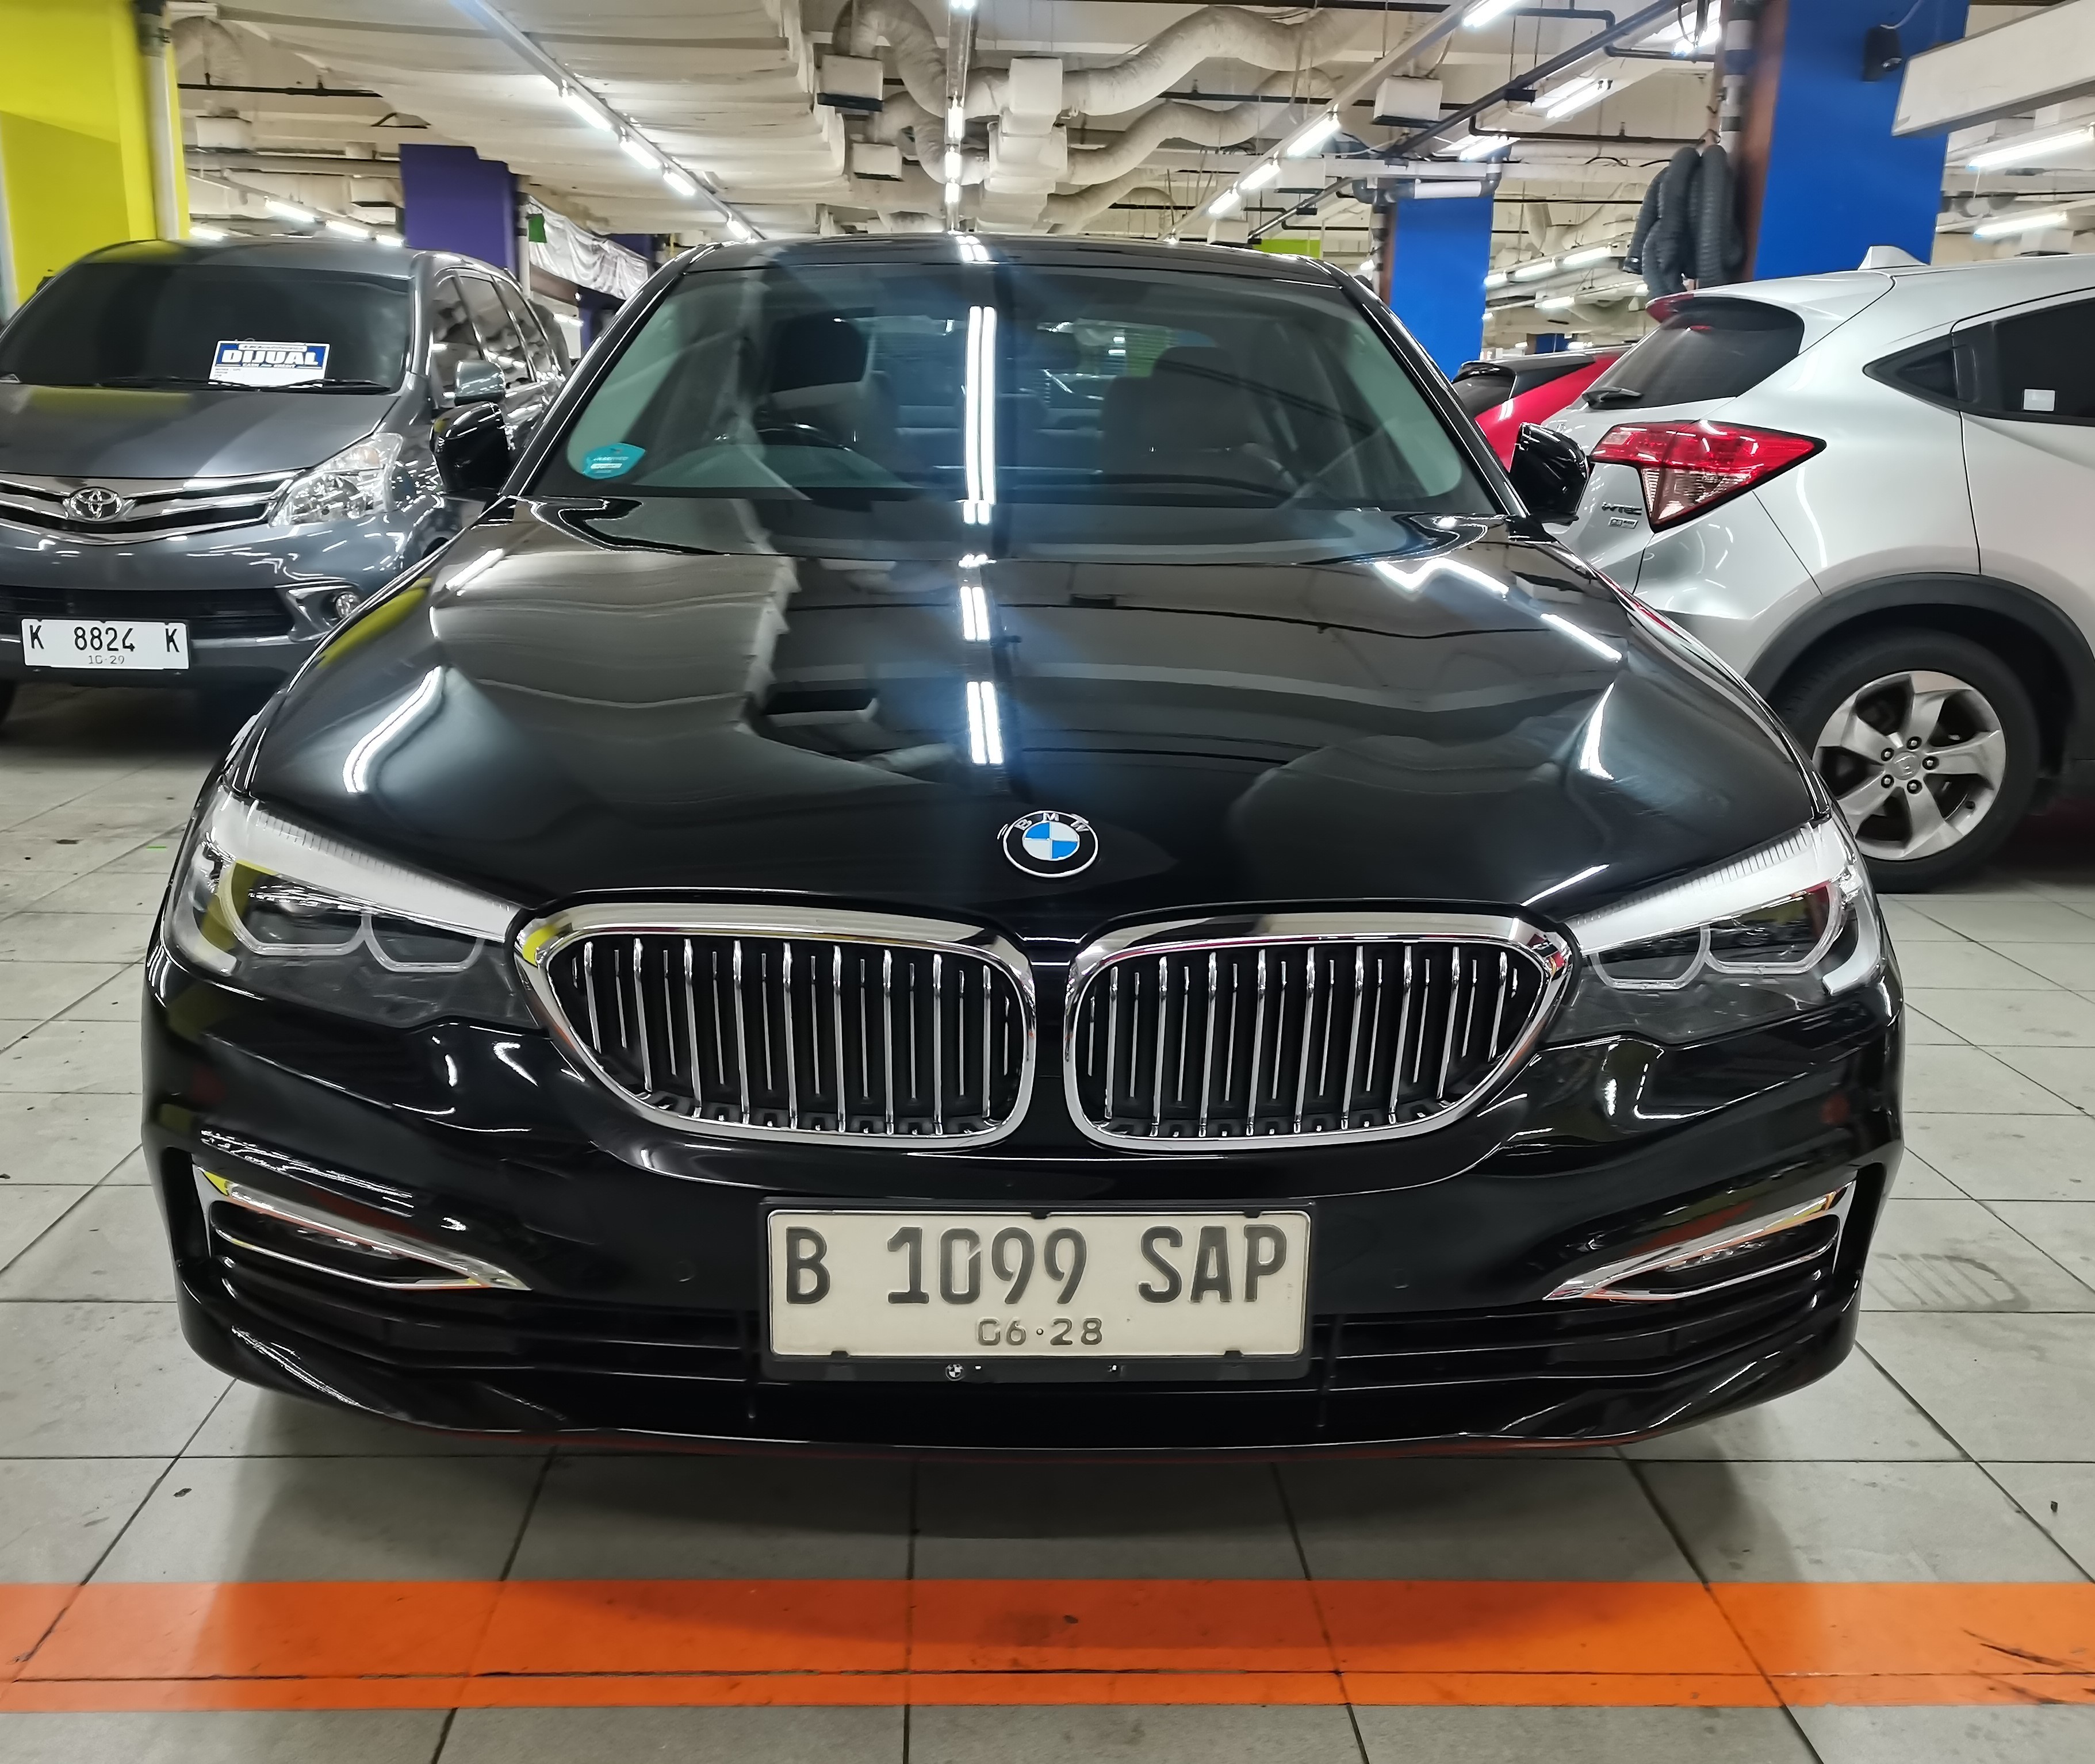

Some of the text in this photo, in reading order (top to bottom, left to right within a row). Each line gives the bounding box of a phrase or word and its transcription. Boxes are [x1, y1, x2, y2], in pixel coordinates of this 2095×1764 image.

[221, 350, 319, 365] DIJUAL
[29, 624, 179, 653] K 8824 K
[1013, 812, 1090, 833] BMW
[786, 1224, 1287, 1305] B 1099 SAP
